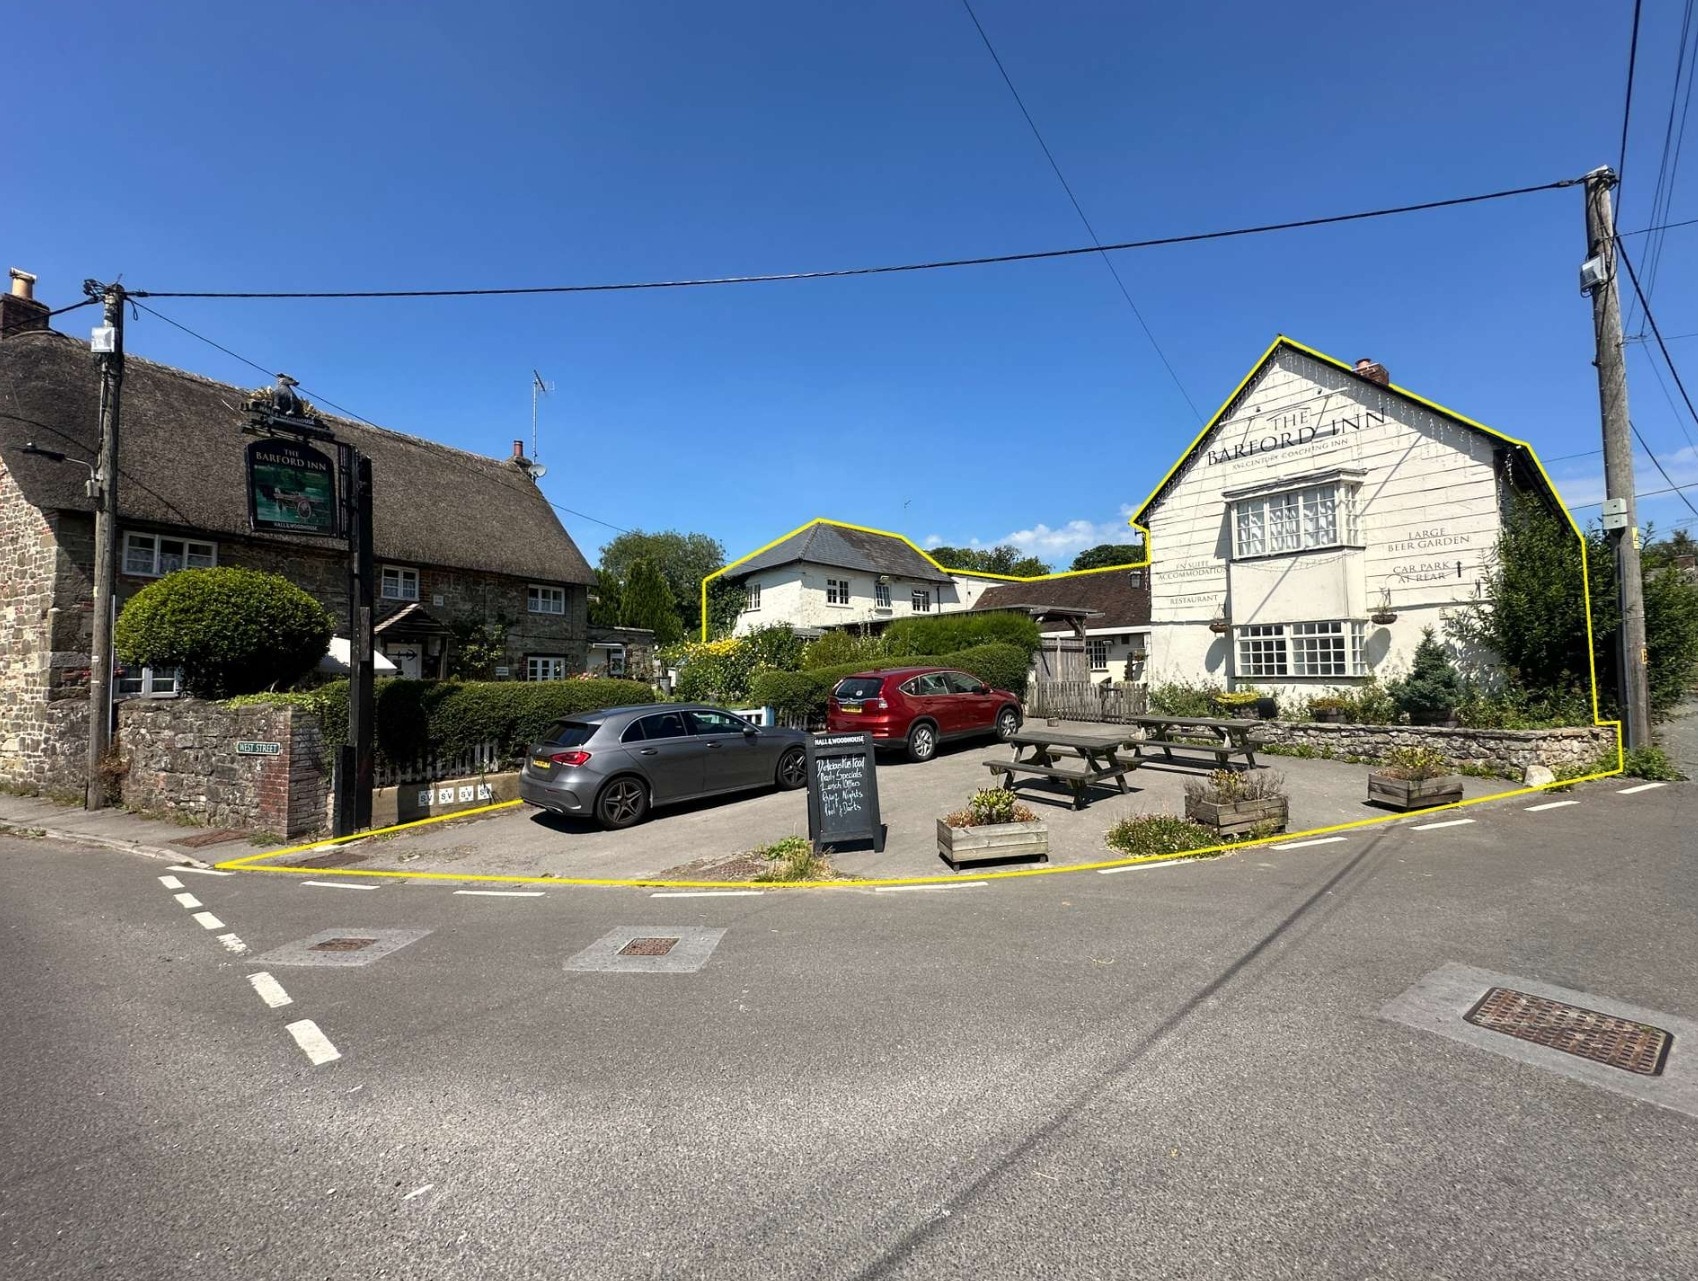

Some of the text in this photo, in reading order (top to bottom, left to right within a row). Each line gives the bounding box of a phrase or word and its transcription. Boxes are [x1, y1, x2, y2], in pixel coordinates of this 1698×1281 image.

[1272, 410, 1309, 431] THE
[1208, 407, 1385, 466] BARFORD INN
[284, 449, 299, 457] THE
[1281, 442, 1329, 459] COACHING
[1331, 438, 1349, 447] INN
[256, 452, 327, 470] BARFORD INN
[1408, 527, 1447, 540] LARGE
[1387, 535, 1471, 552] BEER GARDEN
[1392, 560, 1450, 574] CAR PARK
[1170, 594, 1218, 605] RESTAURANT
[240, 743, 278, 753] WEST STREET
[842, 789, 863, 805] Nights
